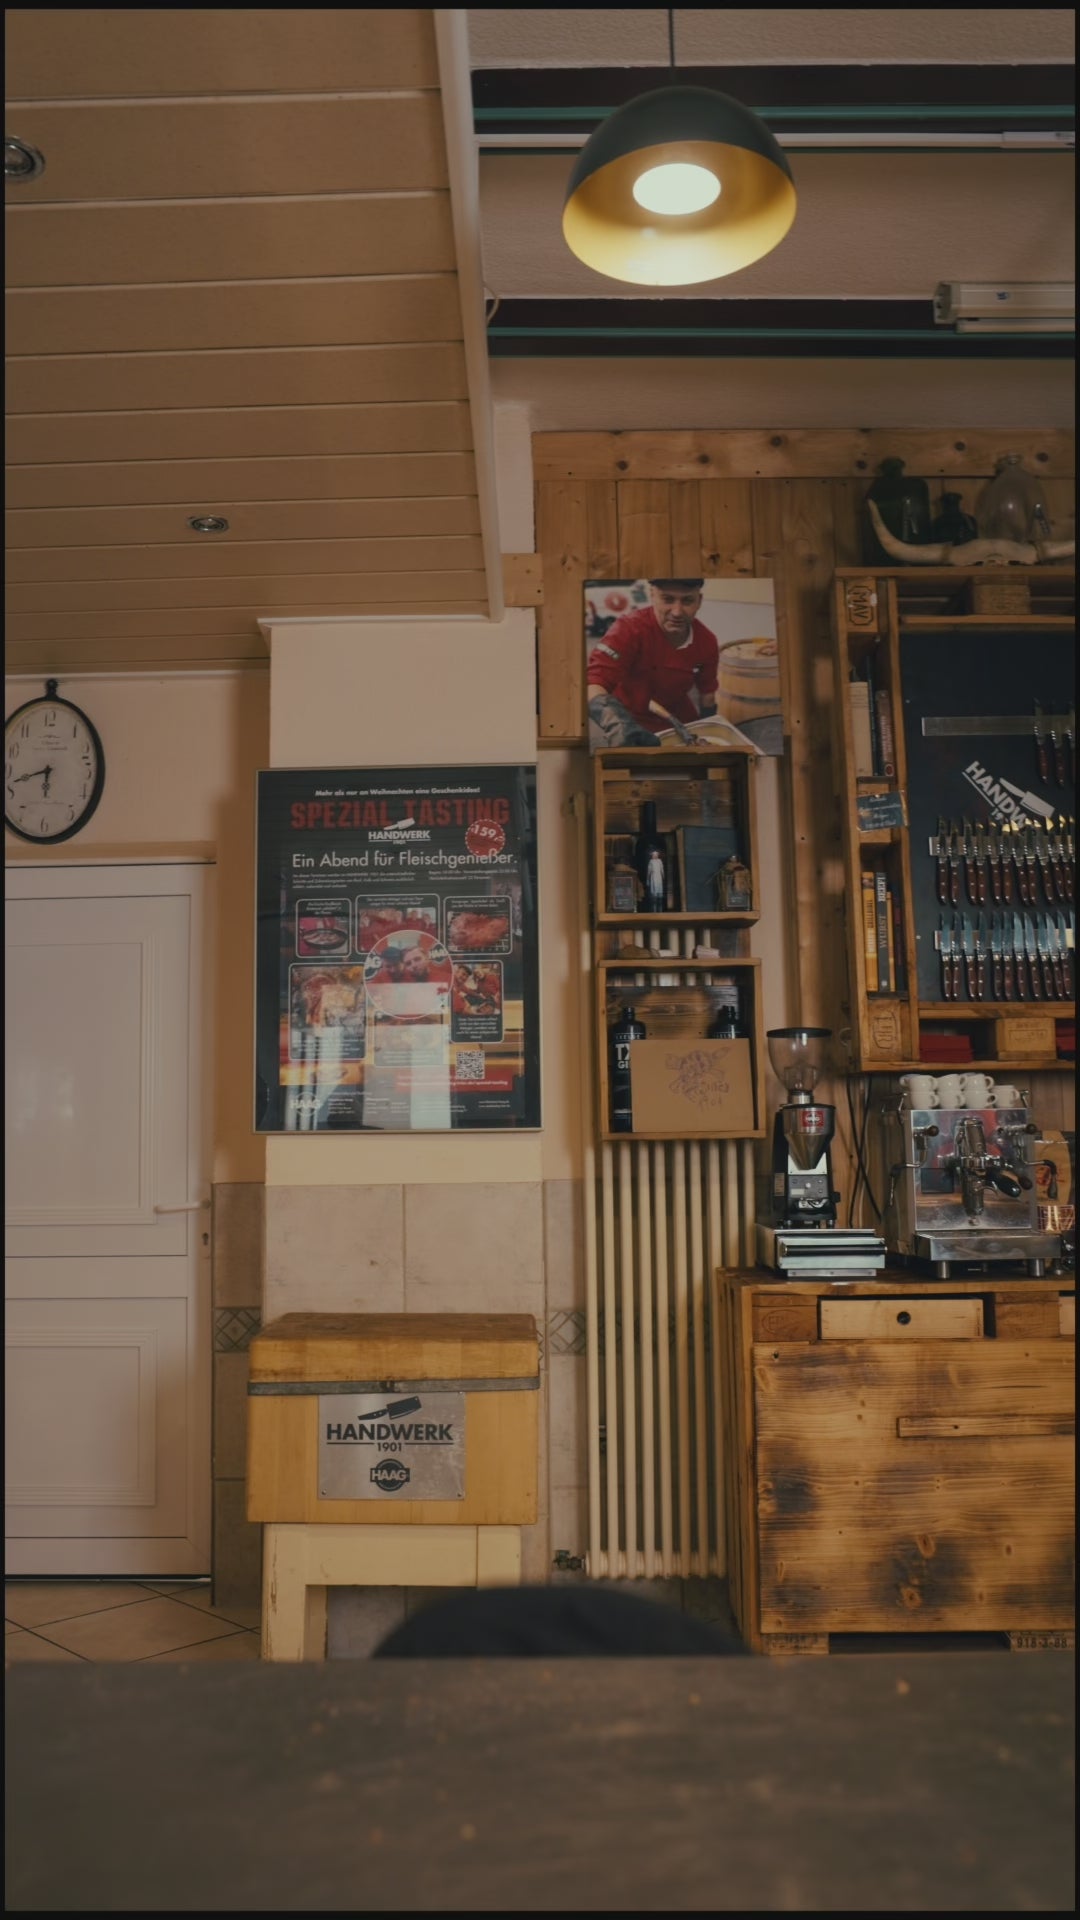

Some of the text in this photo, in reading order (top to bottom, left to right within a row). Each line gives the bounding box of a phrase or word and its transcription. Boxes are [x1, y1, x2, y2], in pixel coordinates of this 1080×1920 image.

[44, 711, 56, 727] 12
[20, 722, 30, 738] 11
[9, 742, 20, 759] 10
[82, 742, 90, 759] 2
[291, 797, 511, 829] SPEZIAL TASTING
[40, 816, 49, 833] 6
[368, 830, 431, 840] HANDWERK
[292, 848, 518, 869] Ein Abend für Fleischgenießer.
[878, 913, 889, 948] WURST
[617, 1061, 629, 1069] GI
[326, 1423, 454, 1441] HANDWERK
[377, 1442, 402, 1452] 1901
[371, 1469, 408, 1481] HAAG
